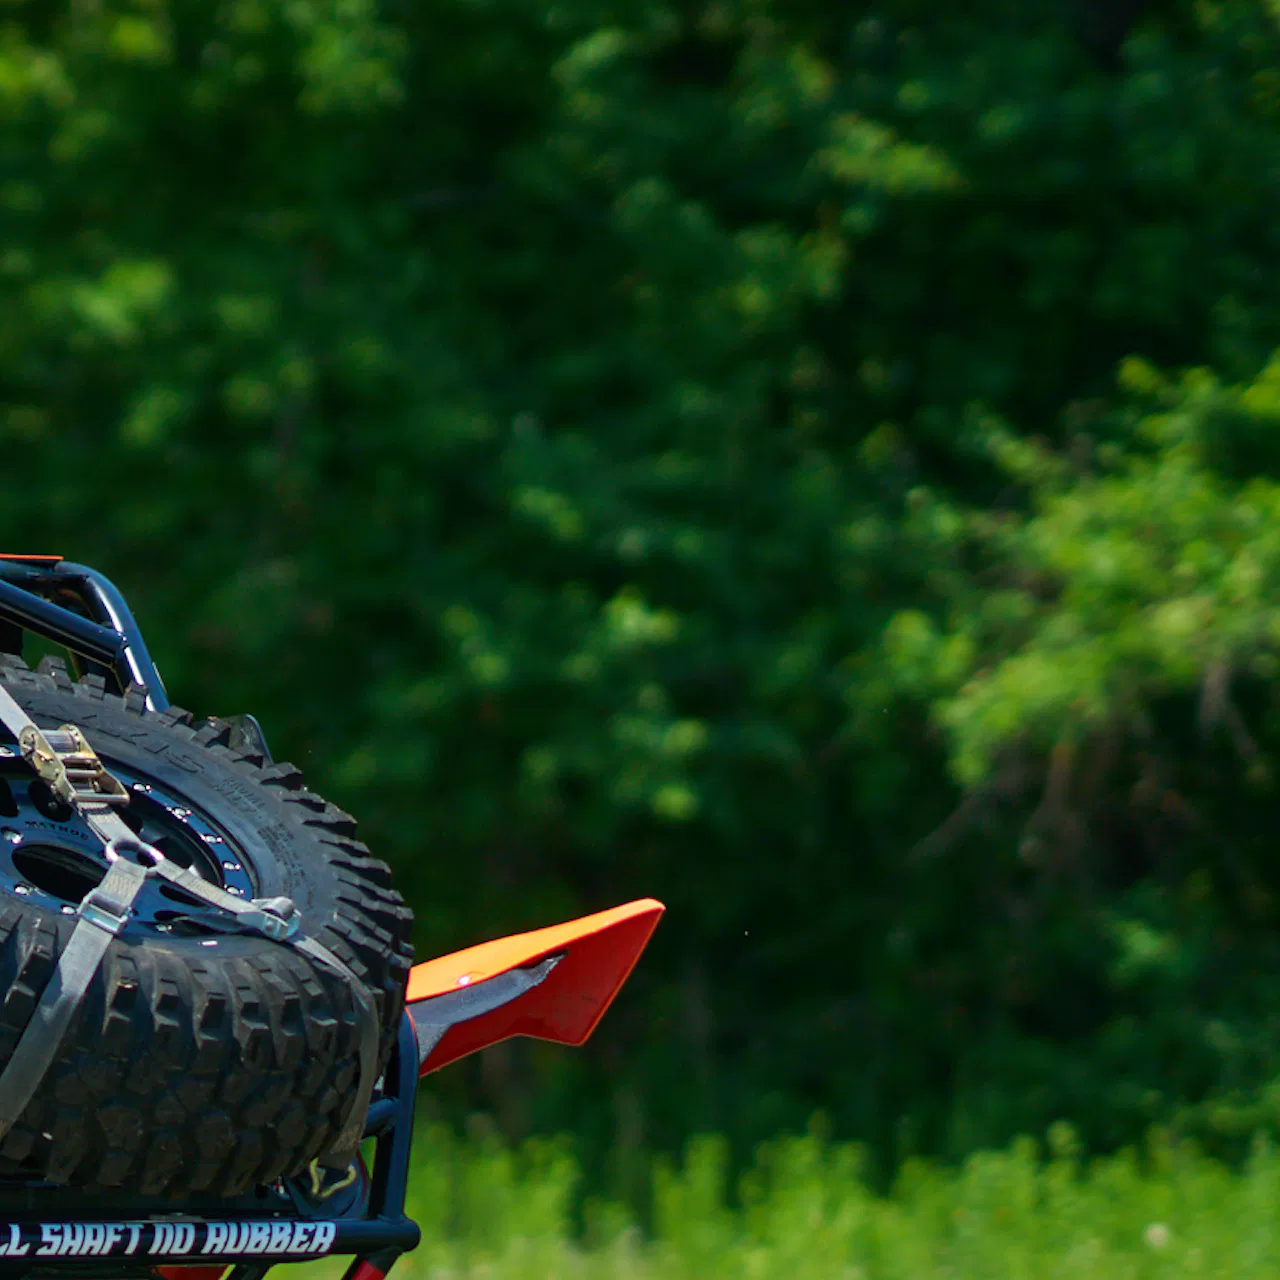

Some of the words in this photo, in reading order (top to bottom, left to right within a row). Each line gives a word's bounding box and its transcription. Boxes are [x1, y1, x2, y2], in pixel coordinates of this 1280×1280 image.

[35, 1222, 144, 1256] SHAFT
[147, 1222, 196, 1255] NO
[200, 1221, 337, 1255] RUBBER
